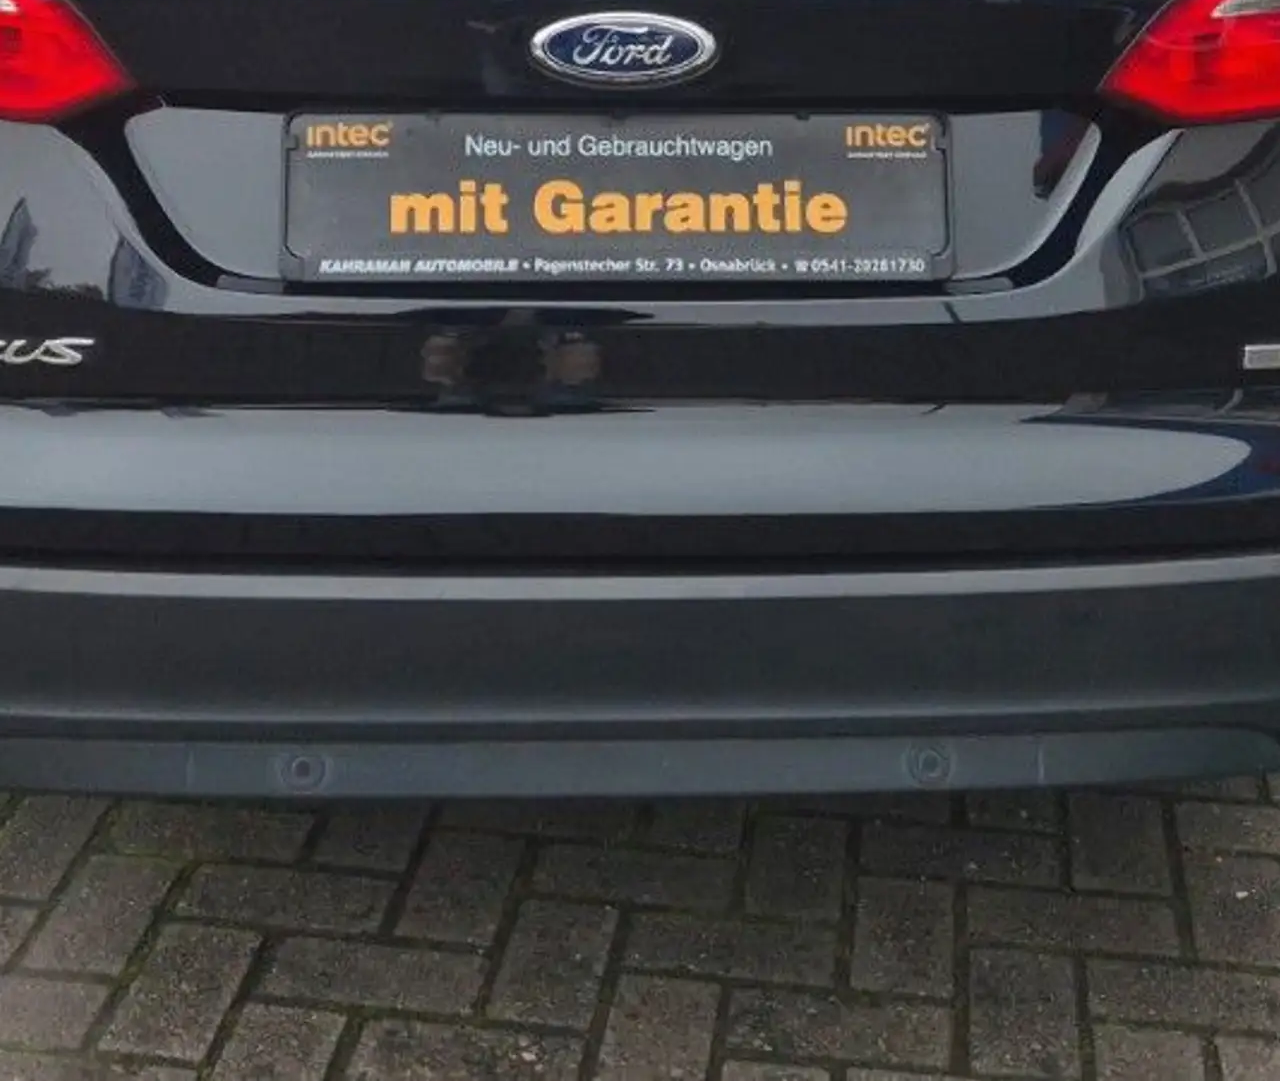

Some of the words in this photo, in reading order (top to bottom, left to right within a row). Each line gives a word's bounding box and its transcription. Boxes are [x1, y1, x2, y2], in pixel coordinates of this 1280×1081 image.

[572, 24, 672, 66] Ford
[306, 122, 390, 147] intec
[846, 123, 927, 147] intec
[465, 134, 519, 157] Neu-
[527, 134, 570, 157] und
[578, 134, 773, 162] Gebrauchtwagen
[389, 179, 509, 234] mit
[533, 179, 848, 235] Garantie
[413, 258, 519, 273] AUTOMOBILE
[534, 257, 630, 275] Pagenstecher
[635, 258, 661, 272] Str.
[664, 258, 683, 272] 73
[700, 257, 776, 272] Osnabrück
